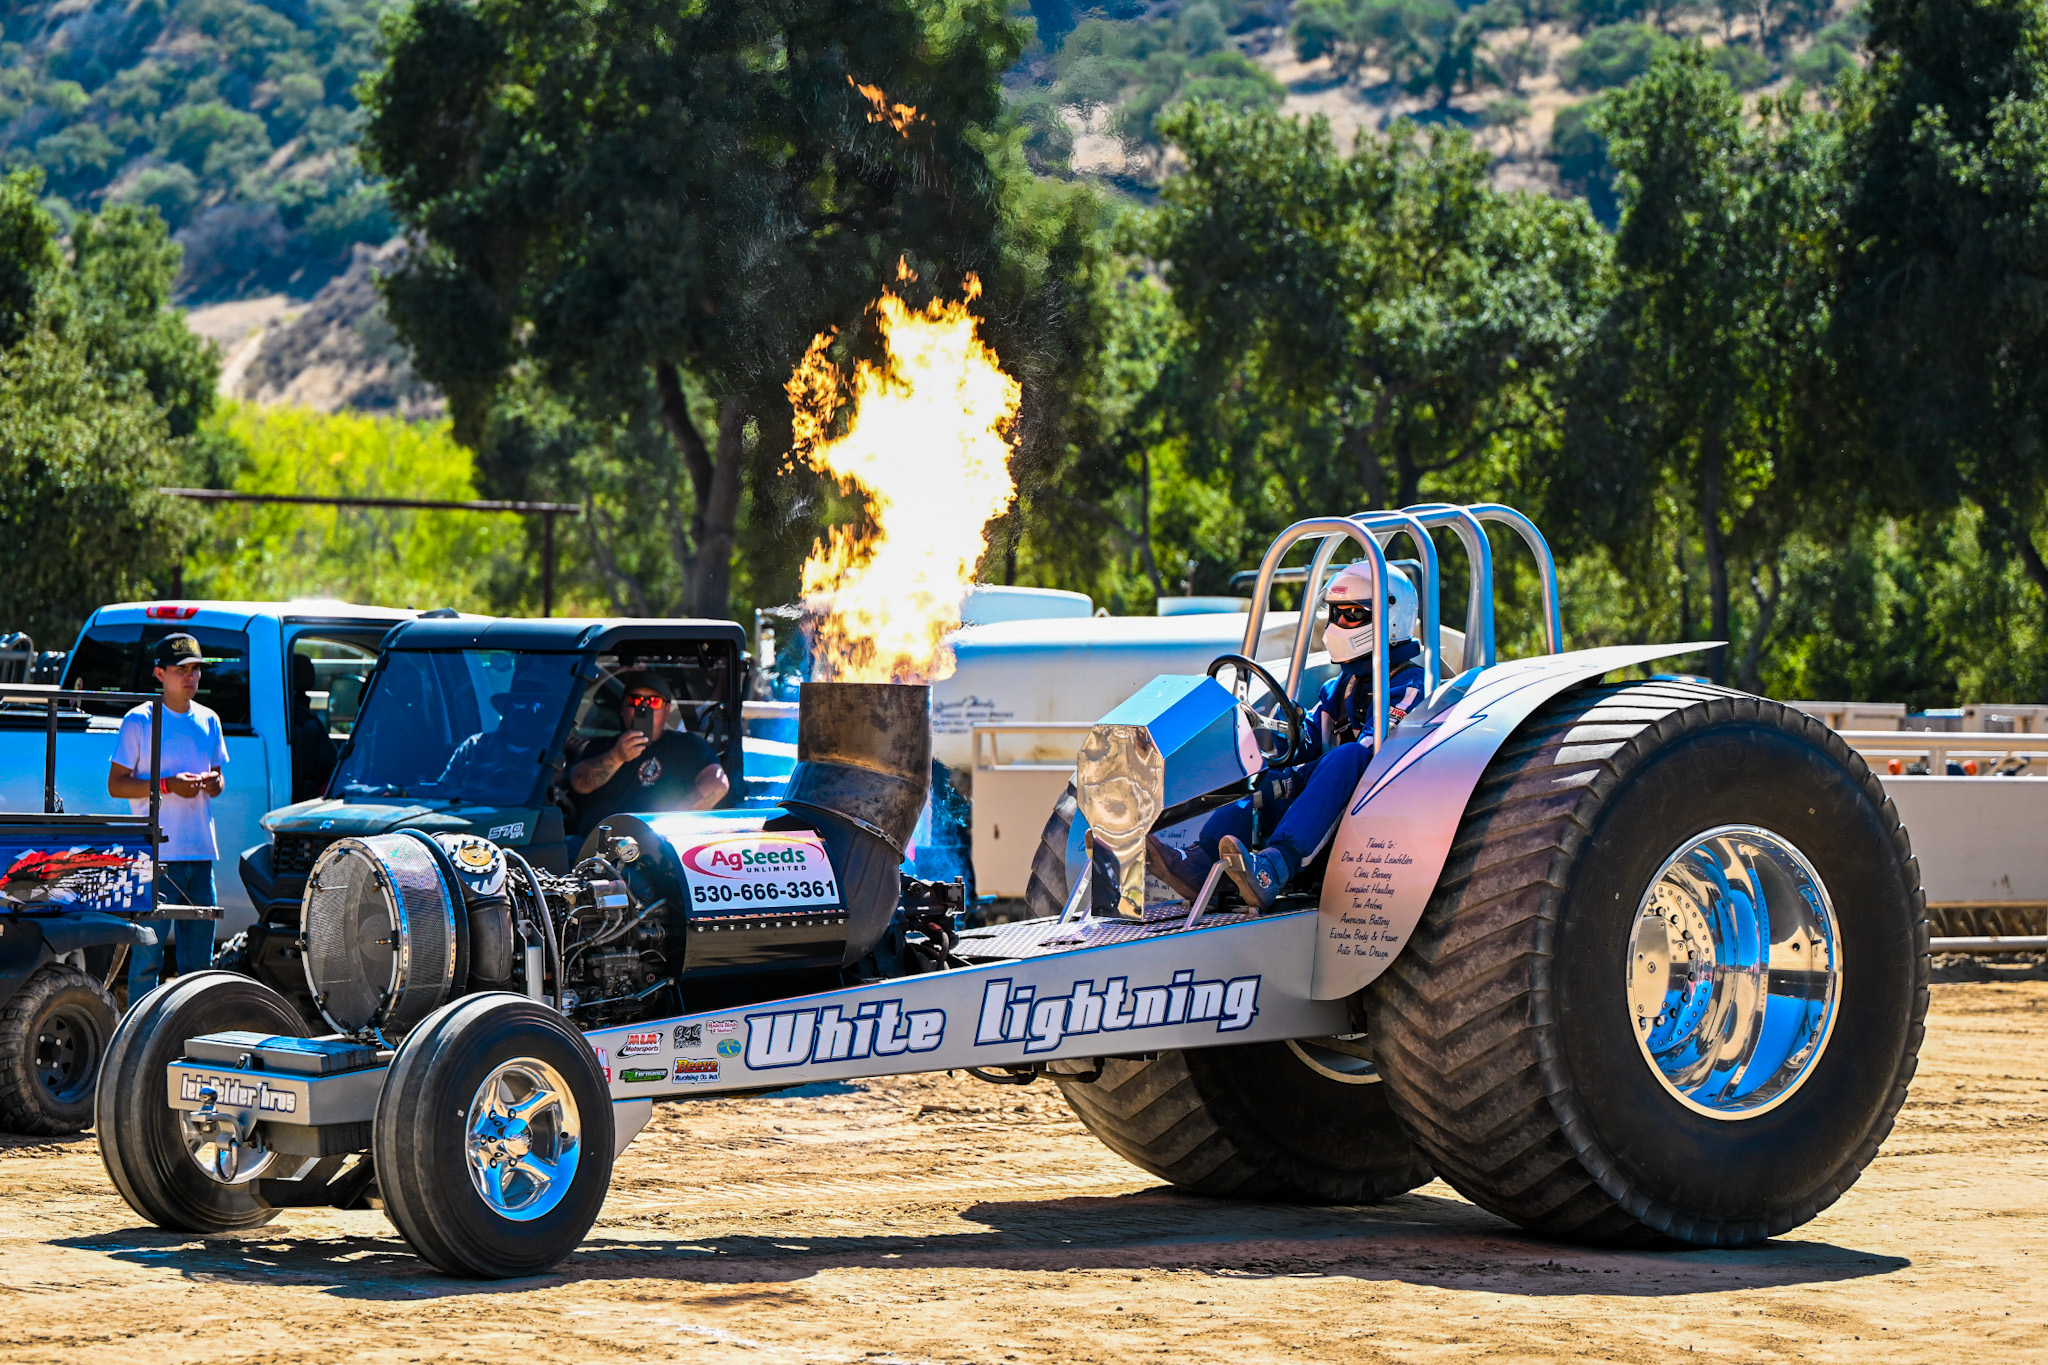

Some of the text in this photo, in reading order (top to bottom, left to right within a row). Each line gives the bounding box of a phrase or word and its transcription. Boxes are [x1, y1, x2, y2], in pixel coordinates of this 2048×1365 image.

[488, 822, 524, 839] 570
[1366, 838, 1385, 849] Thanks
[710, 848, 806, 871] AgSeeds
[1357, 854, 1364, 862] &
[1366, 853, 1382, 864] Linda
[746, 865, 807, 873] UNLIMITED
[1354, 867, 1369, 878] Chris
[694, 880, 836, 903] 530-666-3361
[1345, 882, 1395, 898] Longshot Hauling
[1341, 913, 1391, 929] American Battery
[1354, 929, 1369, 943] Body
[1372, 932, 1378, 941] &
[1382, 931, 1399, 942] Frame
[1337, 944, 1351, 955] Auto
[628, 1034, 657, 1045] MLM
[744, 999, 946, 1071] White
[625, 1045, 659, 1053] Motorsports
[675, 1060, 718, 1073] Reeve
[259, 1082, 297, 1114] bros
